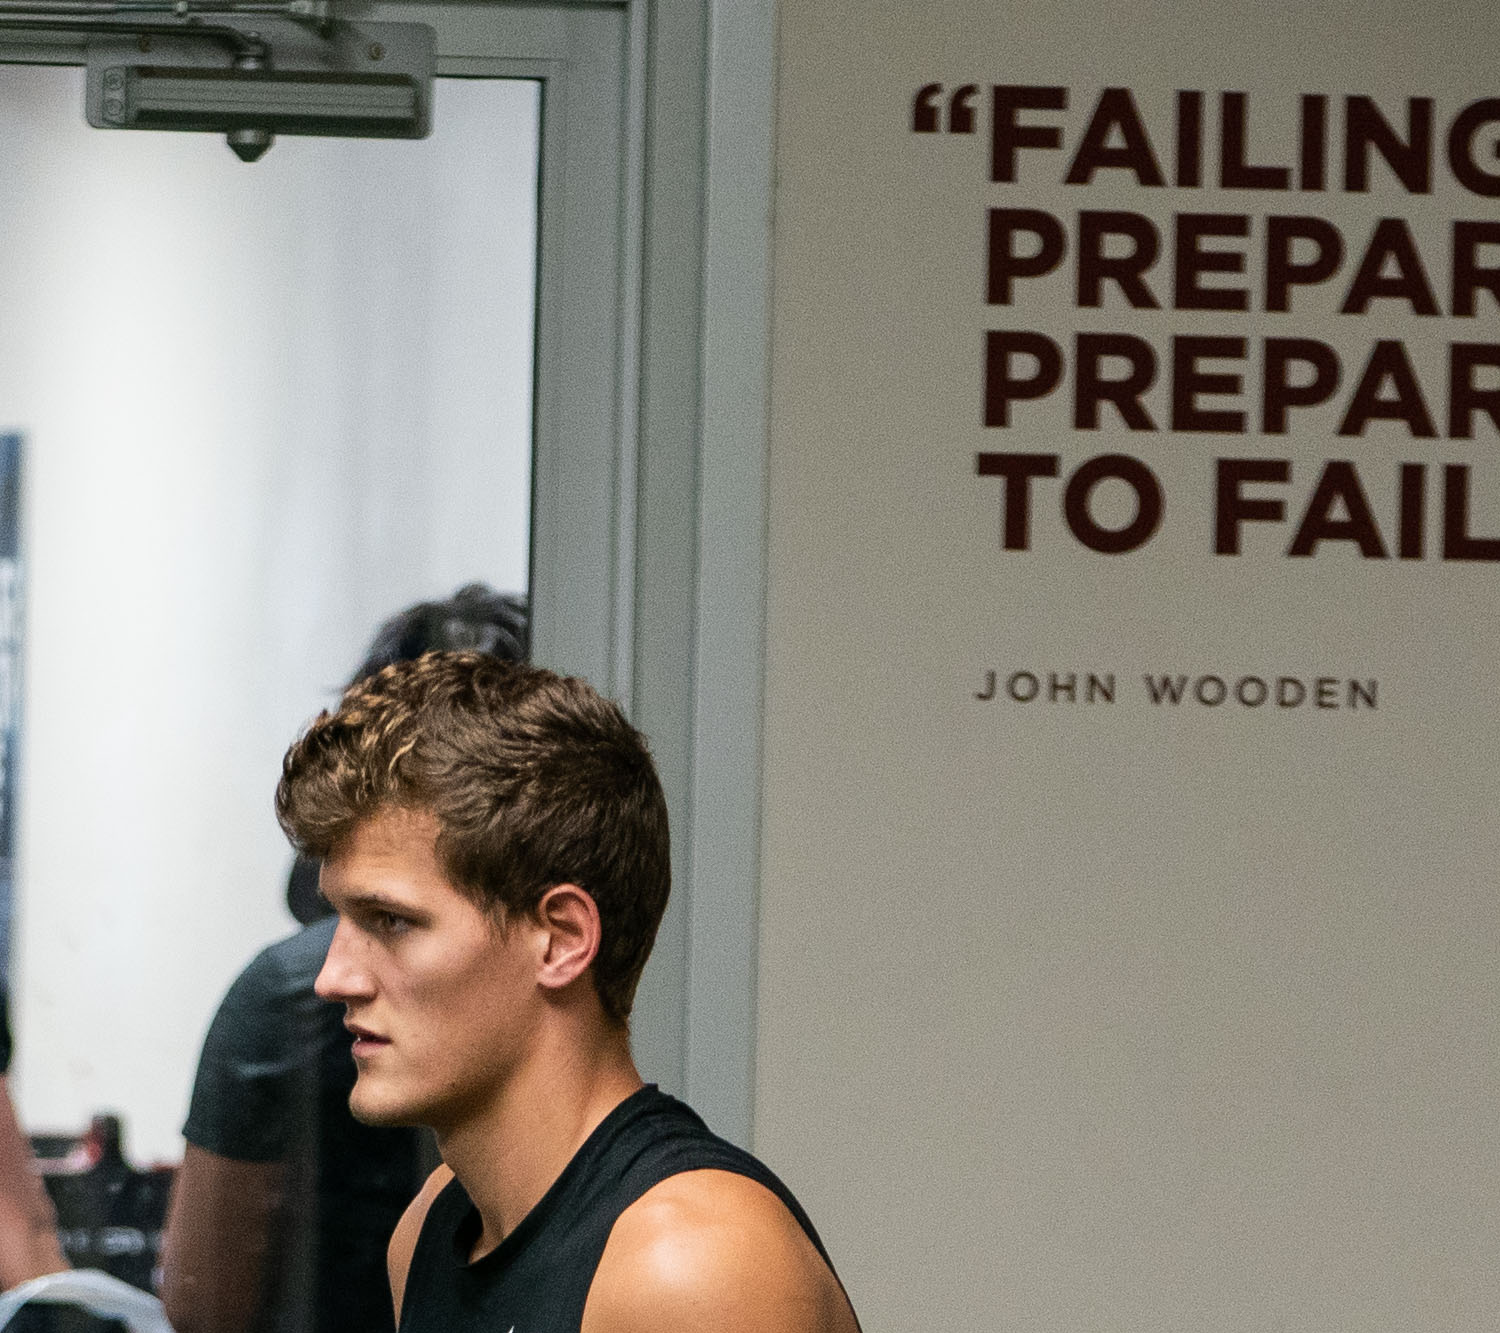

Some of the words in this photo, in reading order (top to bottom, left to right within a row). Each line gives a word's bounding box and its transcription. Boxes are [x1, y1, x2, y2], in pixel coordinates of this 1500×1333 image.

[977, 453, 1164, 554] TO
[976, 671, 1116, 703] JOHN
[1146, 675, 1379, 709] WOODEN
